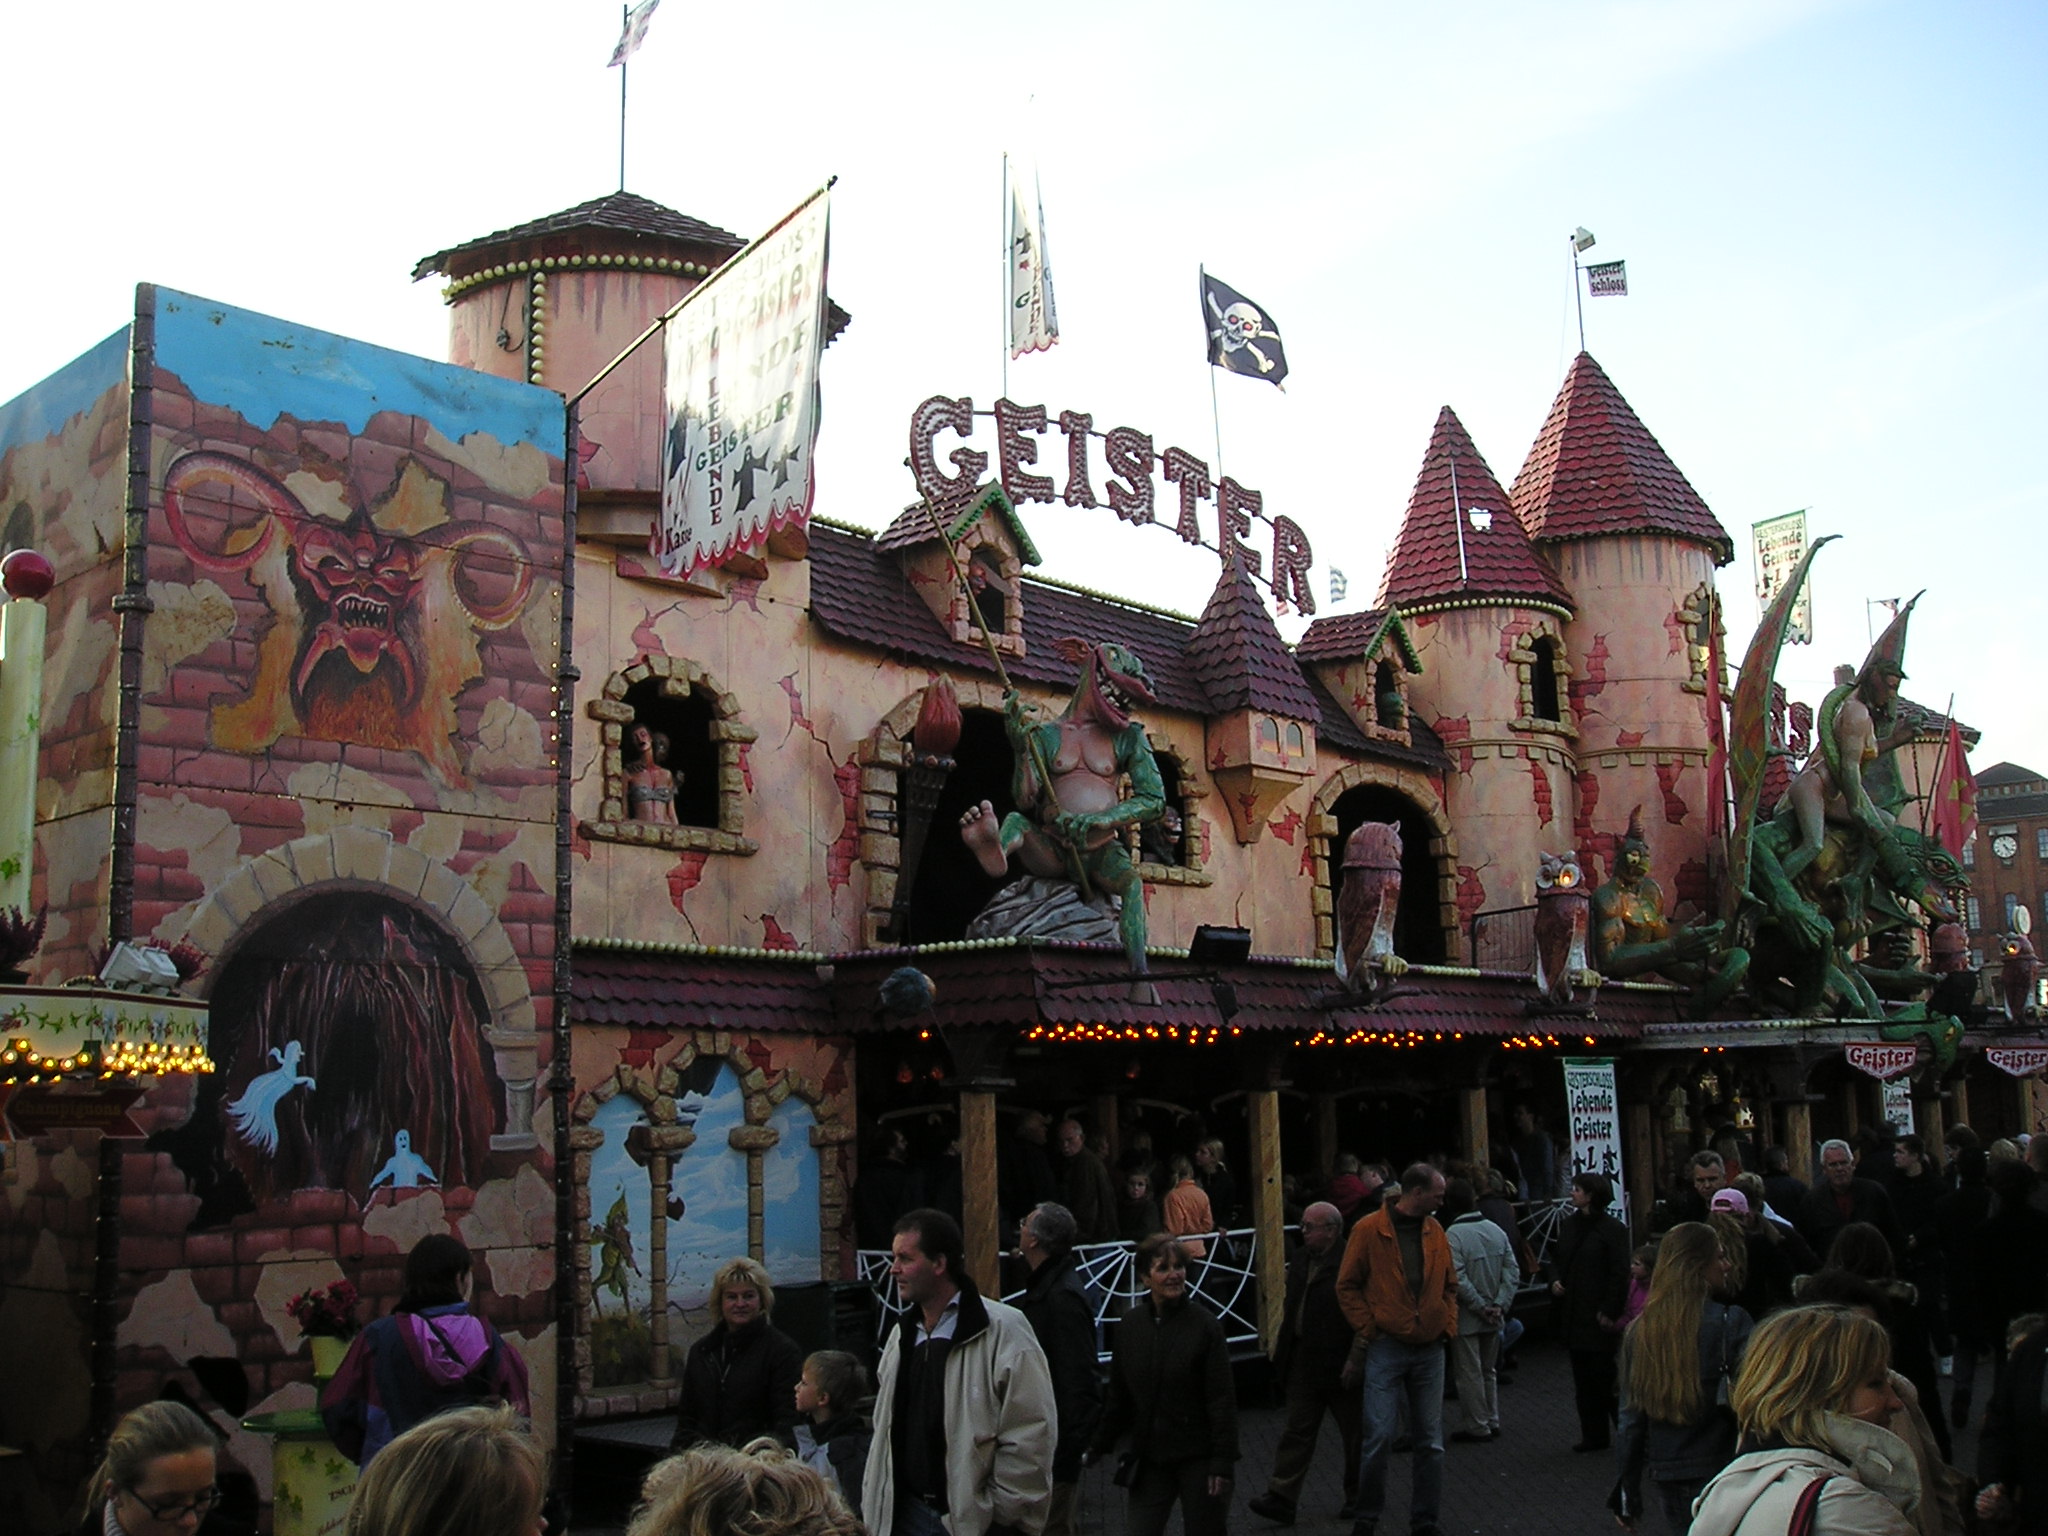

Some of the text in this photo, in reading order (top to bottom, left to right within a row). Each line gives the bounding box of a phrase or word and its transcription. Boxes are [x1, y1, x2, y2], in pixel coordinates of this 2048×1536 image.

[696, 390, 795, 472] GEISTER
[909, 395, 1317, 617] GEISTER
[1758, 531, 1803, 554] Lebende
[1762, 548, 1801, 569] Geister
[1850, 1047, 1914, 1071] Geister
[1990, 1050, 2048, 1069] Geister
[14, 1101, 122, 1120] Champignons
[1570, 1089, 1613, 1115] Lebende
[1573, 1116, 1612, 1142] Geister
